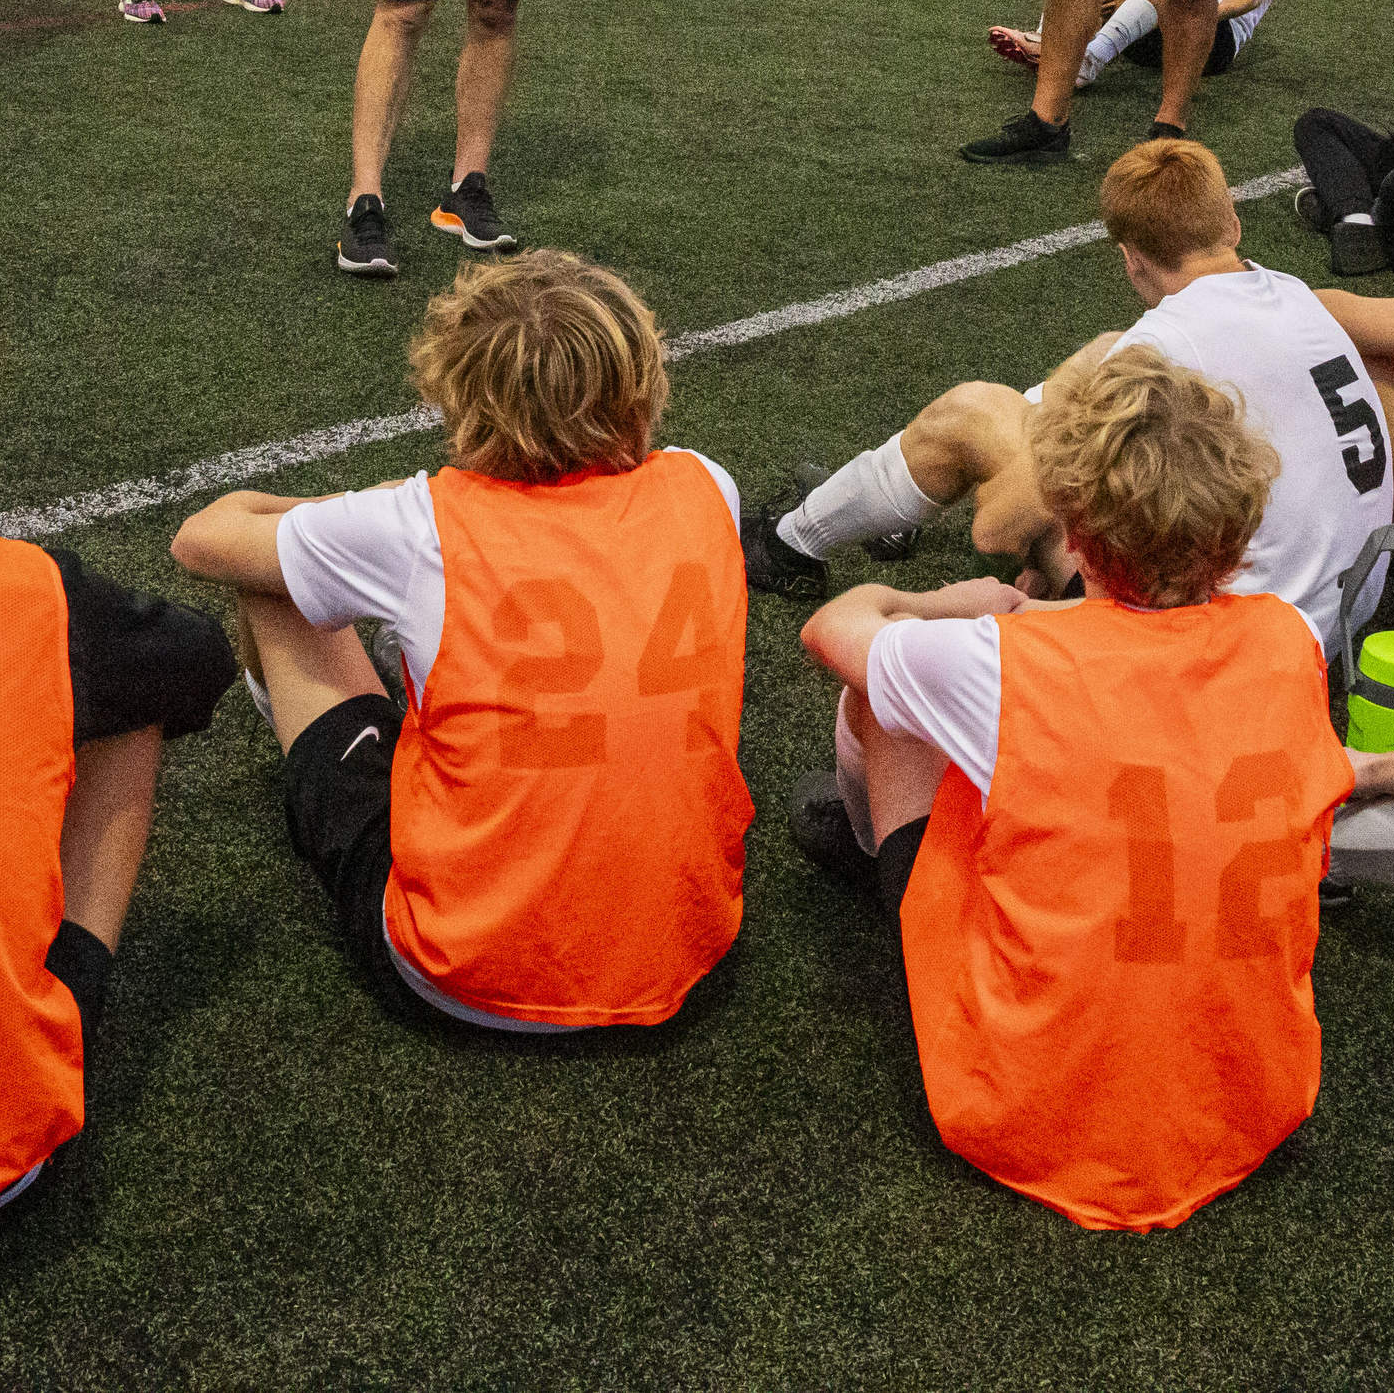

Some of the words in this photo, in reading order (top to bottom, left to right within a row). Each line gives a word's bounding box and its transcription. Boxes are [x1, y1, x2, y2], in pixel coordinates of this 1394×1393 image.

[1308, 354, 1388, 497] 5
[491, 561, 723, 771] 24
[1107, 749, 1311, 965] 12
